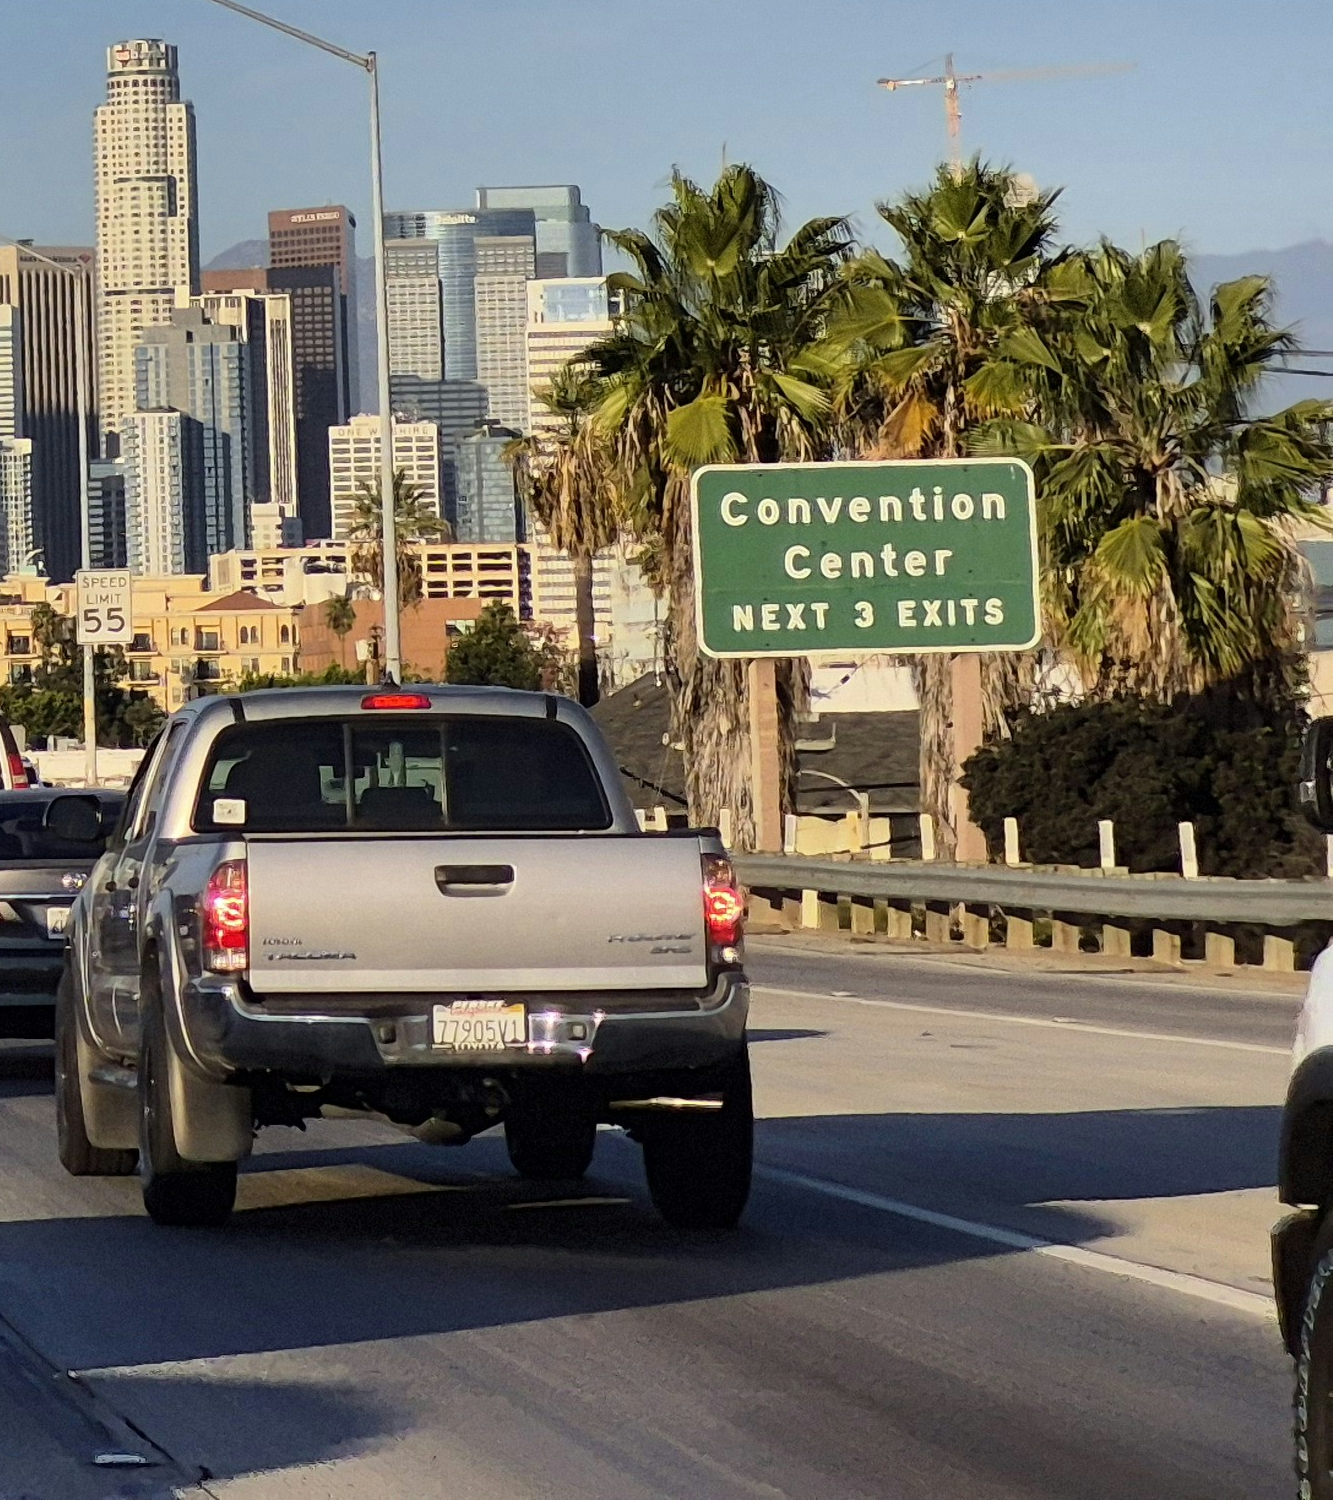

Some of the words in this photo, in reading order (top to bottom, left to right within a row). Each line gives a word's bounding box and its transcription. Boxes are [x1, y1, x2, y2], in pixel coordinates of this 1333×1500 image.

[369, 425, 429, 437] WSHIRE
[720, 486, 1006, 526] Convention
[784, 542, 954, 579] Center
[82, 576, 127, 589] SPEED
[86, 593, 122, 605] LIMIT
[83, 607, 125, 634] 55
[732, 602, 830, 632] NEXT
[854, 601, 875, 628] 3
[897, 598, 1005, 628] EXITS
[437, 1019, 517, 1043] 77905V1
